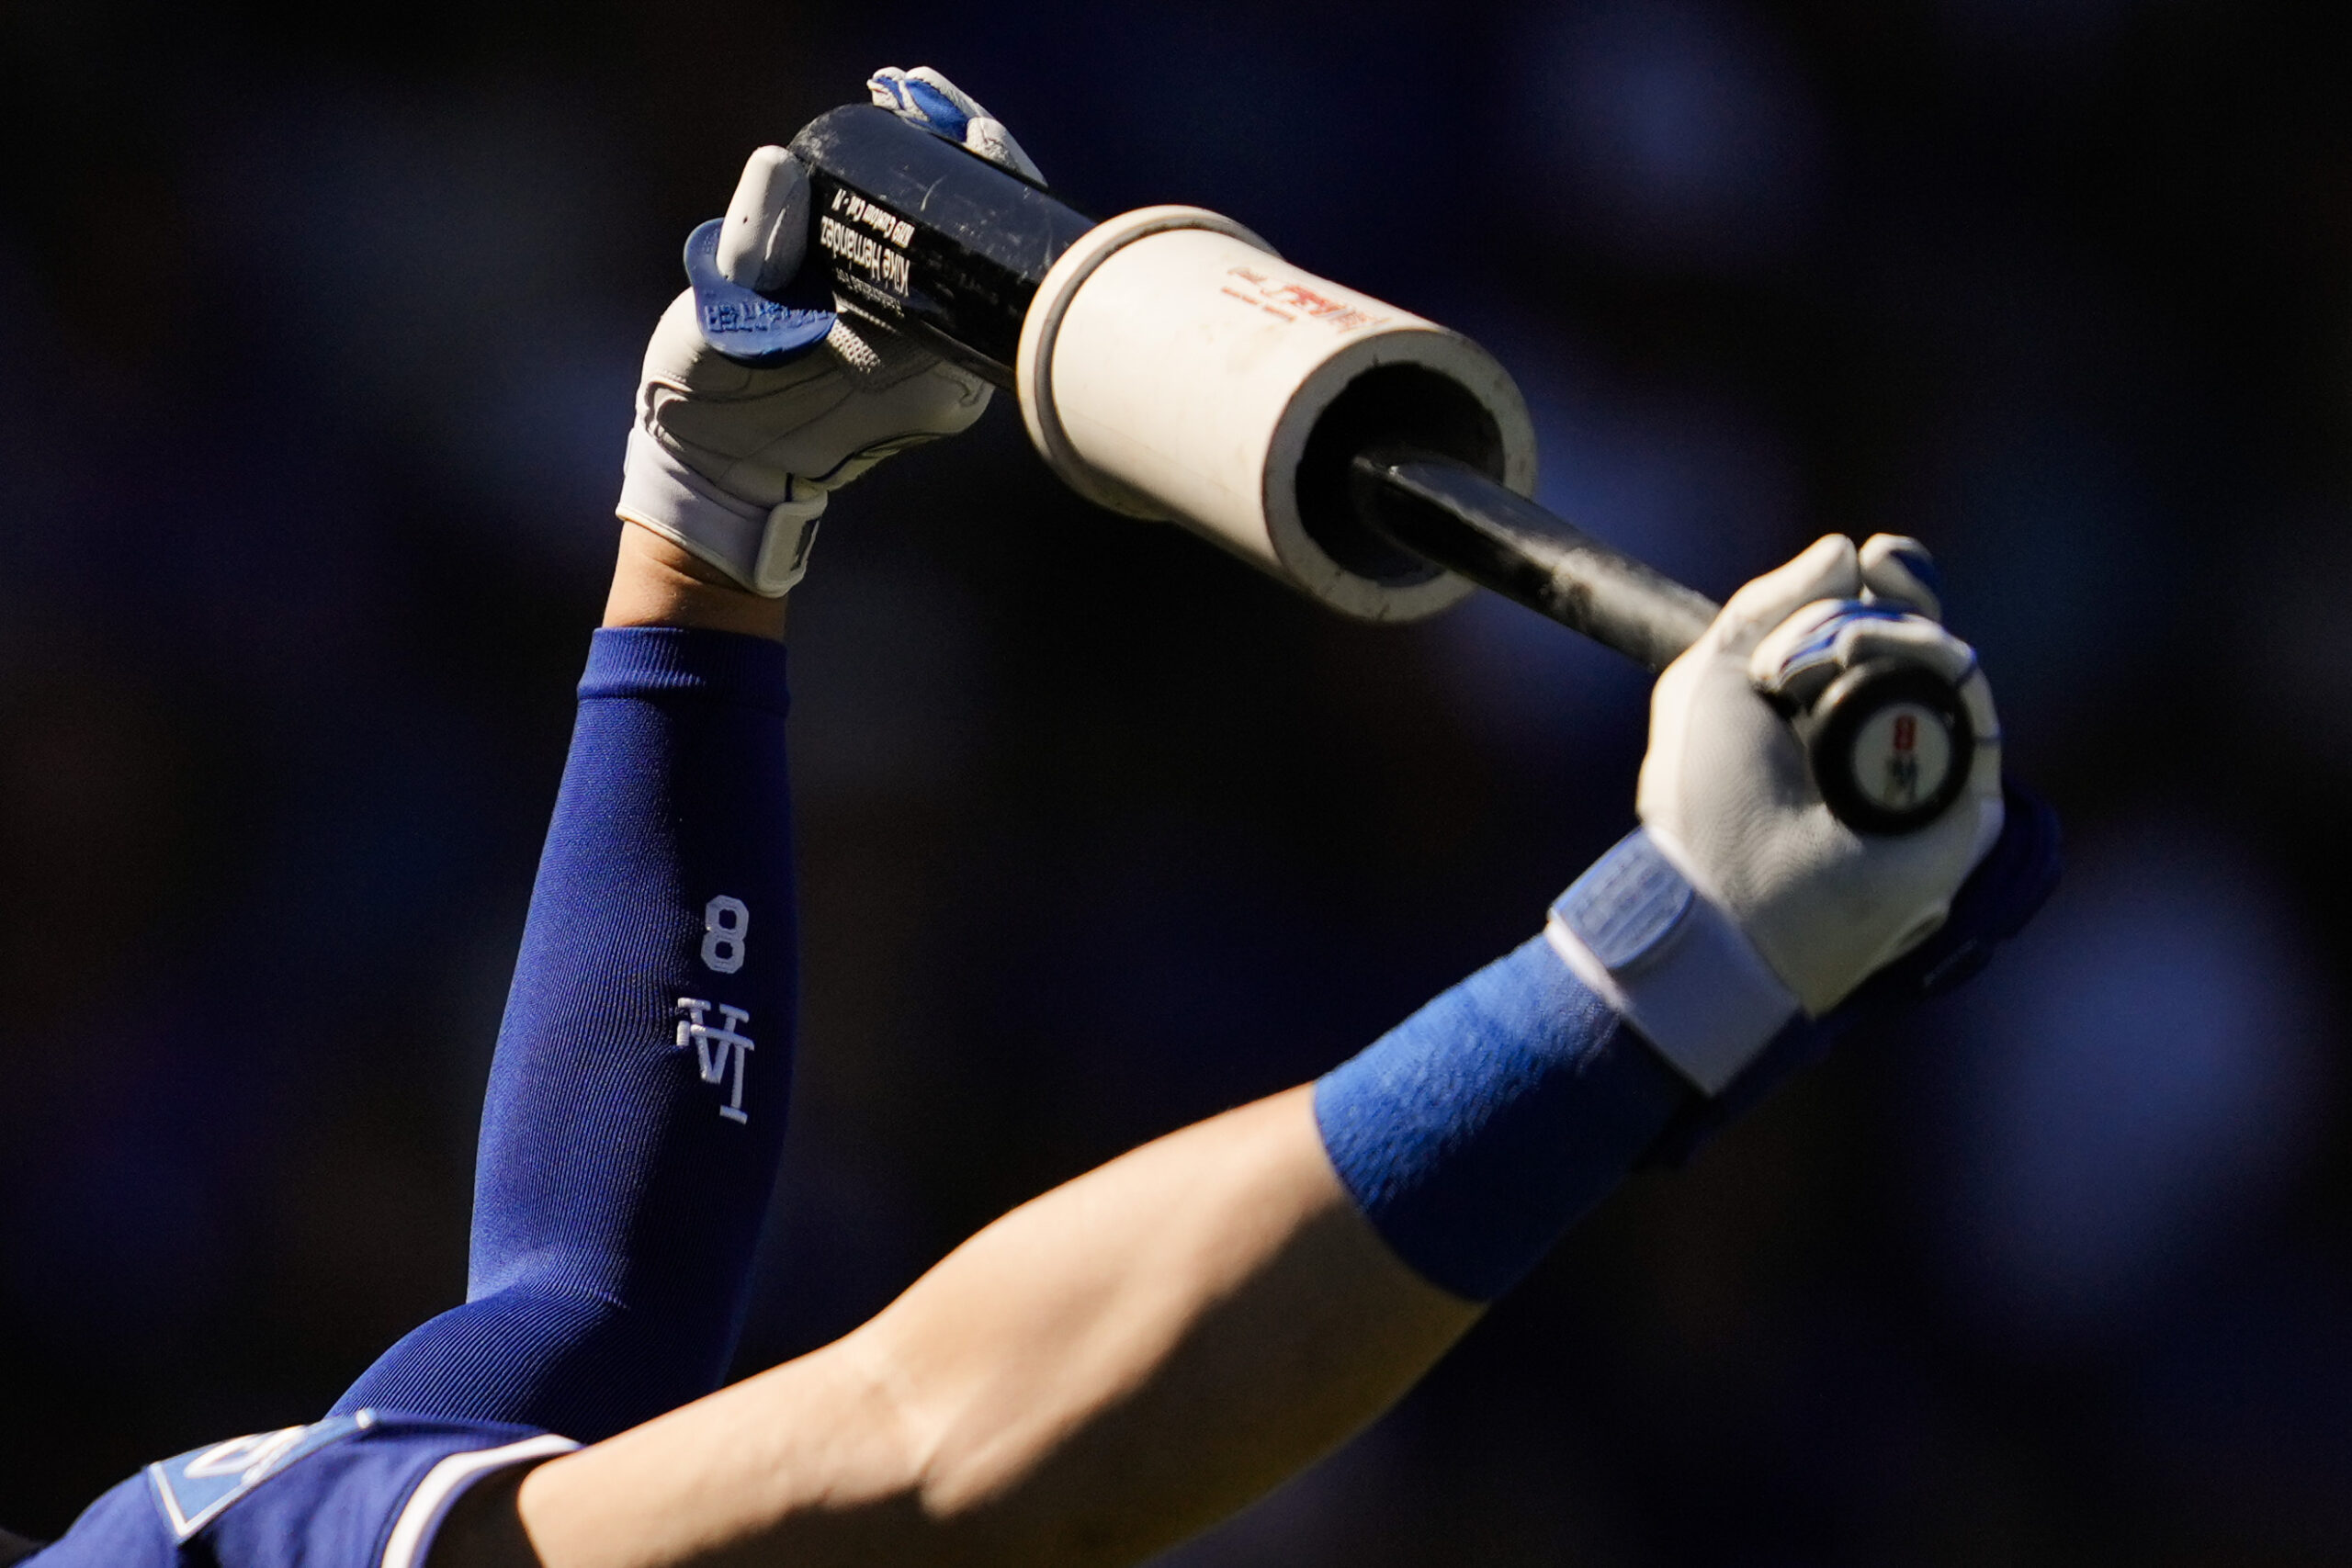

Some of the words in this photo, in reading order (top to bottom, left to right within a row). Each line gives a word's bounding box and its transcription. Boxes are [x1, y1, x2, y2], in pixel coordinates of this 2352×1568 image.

[845, 195, 866, 222] Cut
[862, 203, 897, 239] Custom
[701, 895, 750, 975] 8
